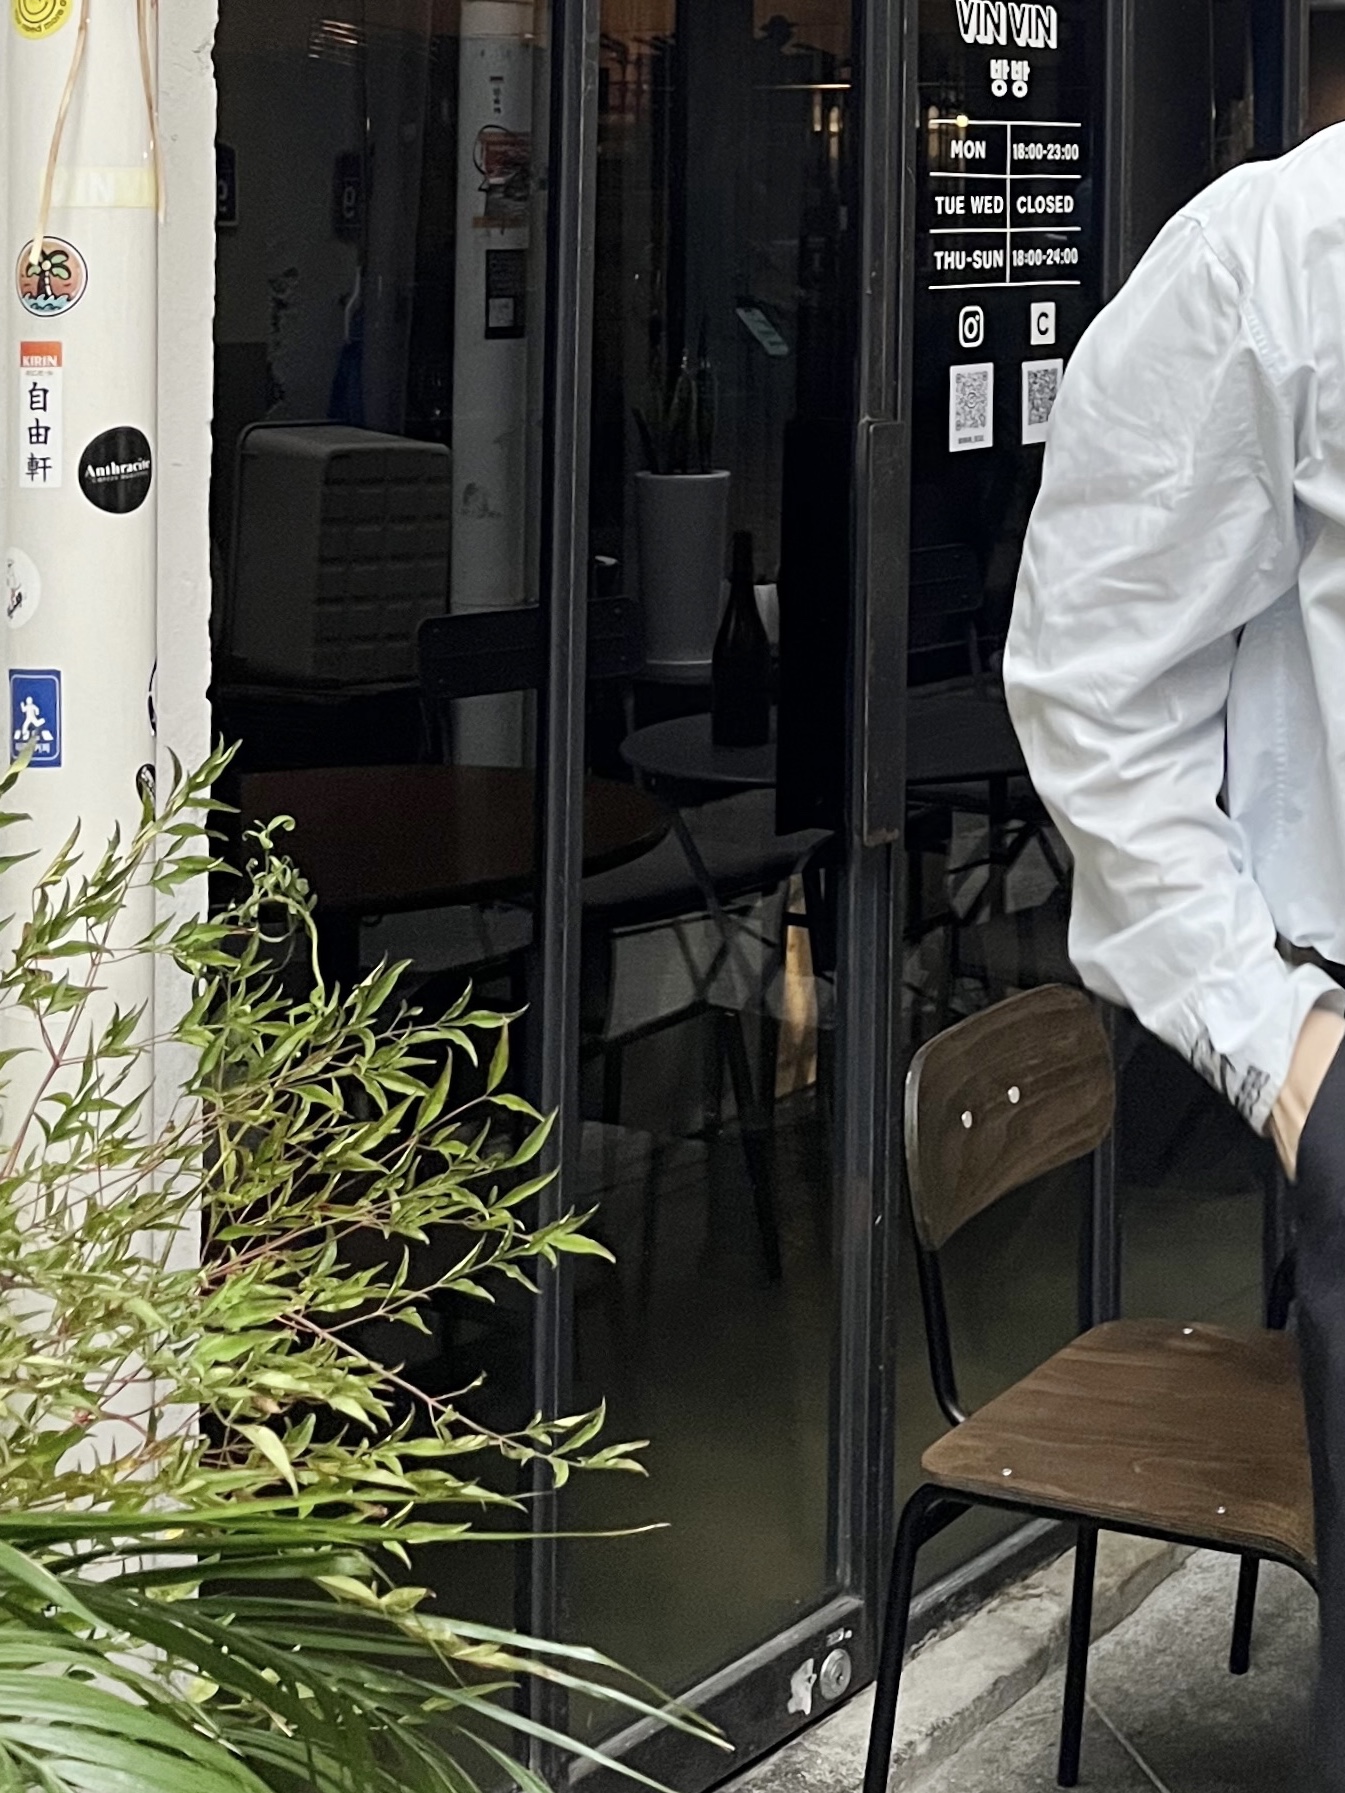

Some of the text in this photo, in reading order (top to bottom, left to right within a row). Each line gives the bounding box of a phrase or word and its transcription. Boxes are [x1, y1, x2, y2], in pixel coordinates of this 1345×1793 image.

[990, 59, 1030, 99] 방방
[950, 139, 1079, 161] MON 18:00-23:00
[935, 196, 1074, 215] TUE WED CLOSED
[934, 247, 1078, 270] THU-SUN 18:00-24:00
[22, 355, 58, 367] KIRIN
[26, 382, 52, 483] 自由軒
